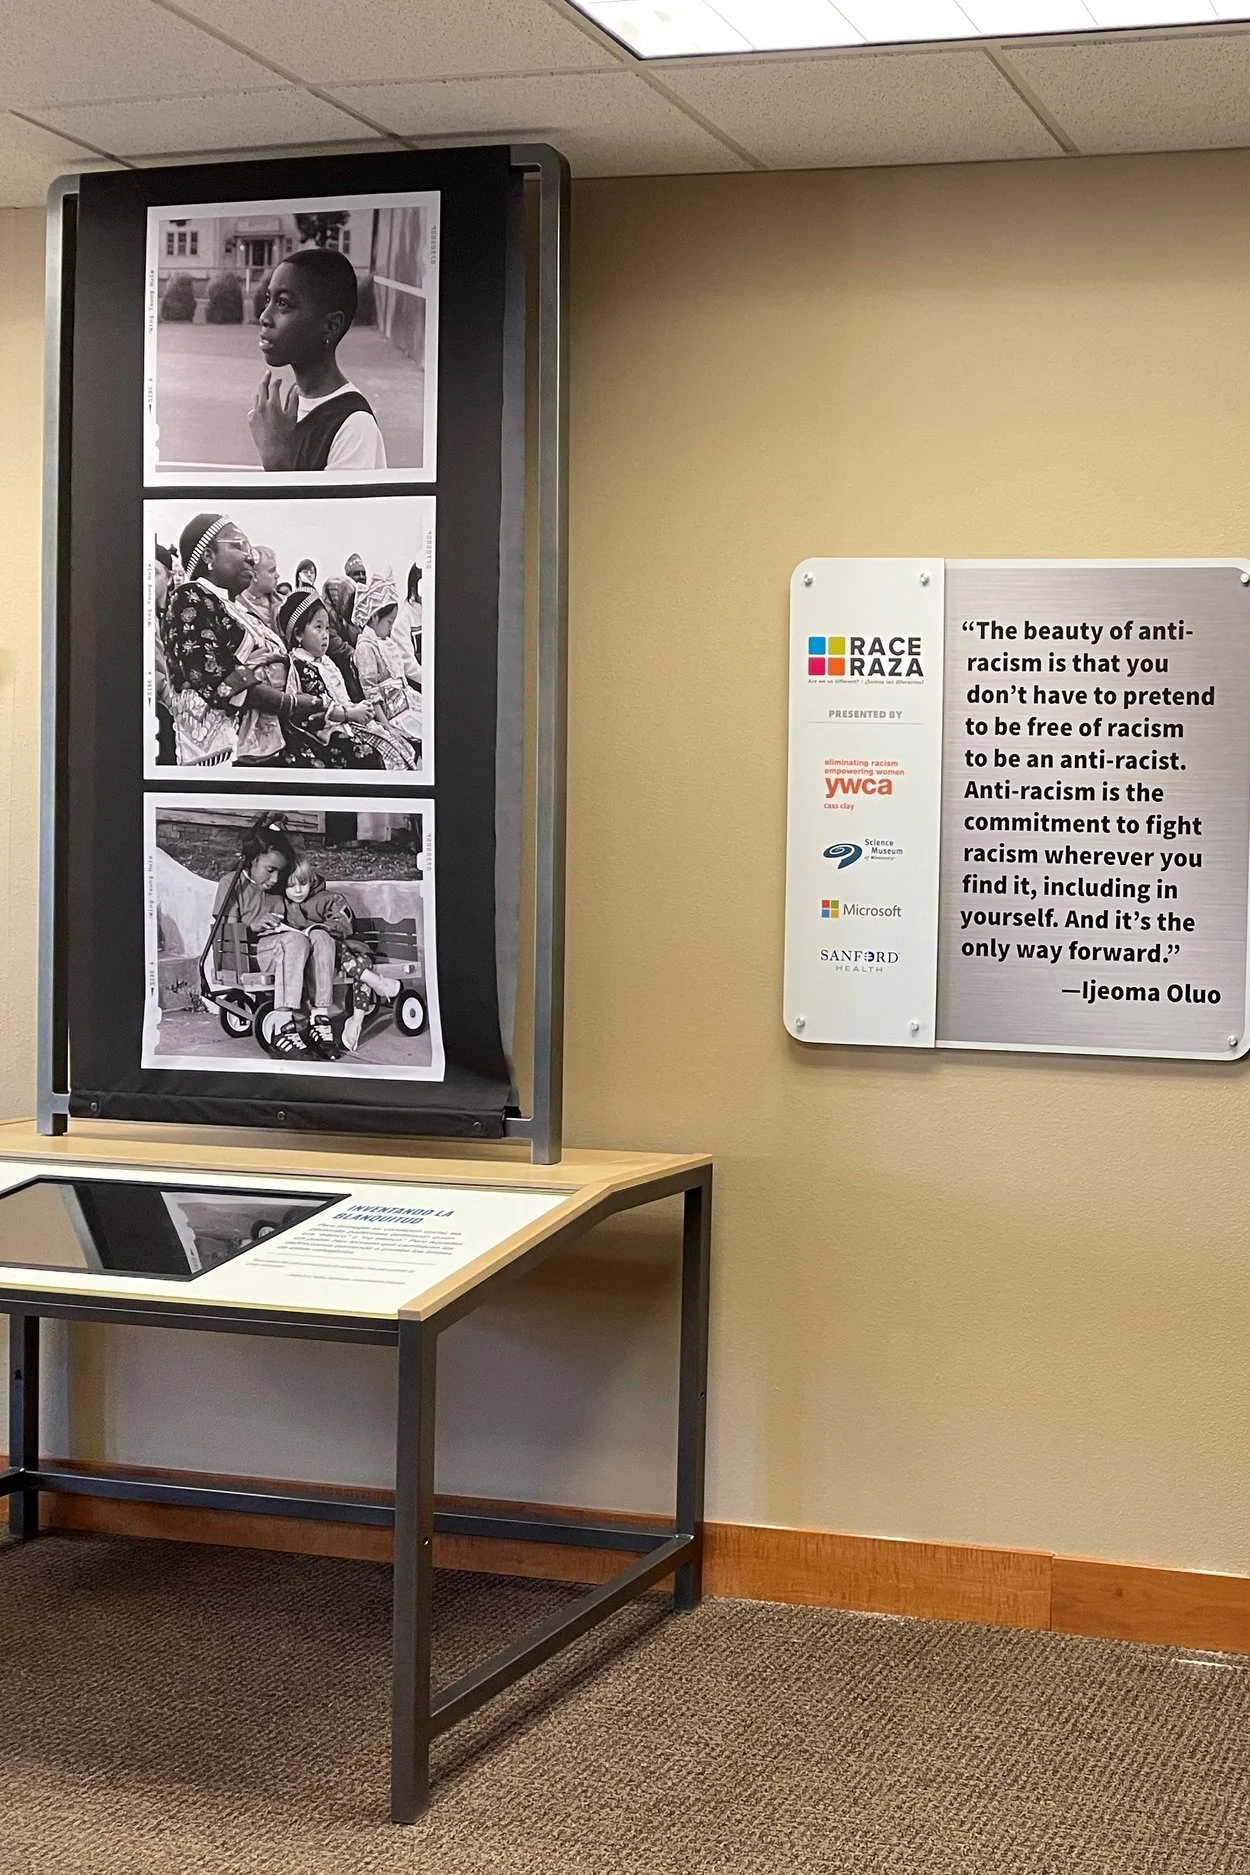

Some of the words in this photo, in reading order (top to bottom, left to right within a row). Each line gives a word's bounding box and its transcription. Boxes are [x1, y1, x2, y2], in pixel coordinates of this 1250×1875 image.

[963, 621, 1017, 639] “The
[1025, 621, 1103, 644] beauty
[1110, 621, 1133, 639] of
[1139, 620, 1193, 640] anti-
[850, 637, 921, 656] RACE
[850, 657, 924, 677] RAZA
[968, 652, 1041, 671] racism
[1049, 652, 1066, 672] is
[1072, 653, 1120, 672] that
[1127, 659, 1168, 677] you
[967, 685, 1026, 703] don’t
[1034, 685, 1087, 704] have
[1094, 687, 1116, 704] to
[1124, 686, 1214, 709] pretend
[829, 710, 886, 718] PRESENTED
[889, 710, 903, 718] BY
[966, 718, 987, 735] to
[995, 717, 1020, 735] be
[1028, 717, 1072, 736] free
[1079, 718, 1102, 736] of
[1108, 717, 1183, 737] racism
[824, 759, 869, 767] eliminating
[965, 750, 987, 767] to
[995, 749, 1020, 767] be
[1027, 754, 1053, 768] an
[1061, 749, 1186, 770] anti-racist.
[824, 768, 874, 776] empowering
[825, 777, 893, 799] ywca
[964, 780, 1094, 800] Anti-racism
[1103, 781, 1119, 801] is
[1126, 783, 1163, 802] the
[840, 803, 855, 811] clay
[965, 812, 1110, 833] commitment
[1117, 817, 1139, 833] to
[1146, 815, 1201, 839] fight
[864, 838, 894, 846] Science
[871, 847, 903, 855] Museum
[965, 843, 1037, 863] racism
[1045, 846, 1154, 866] wherever
[1160, 853, 1201, 871] you
[963, 874, 1006, 894] find
[1014, 875, 1036, 900] it,
[1044, 876, 1150, 903] including
[1157, 879, 1177, 898] in
[843, 904, 902, 918] Microsoft
[961, 908, 1058, 929] yourself.
[1065, 910, 1108, 928] And
[1116, 910, 1150, 930] it’s
[1157, 912, 1195, 931] the
[821, 950, 899, 963] SANFORD
[962, 938, 1010, 962] only
[1017, 944, 1062, 963] way
[1069, 941, 1179, 963] forward.”
[1062, 980, 1159, 1003] —Ijeoma
[1168, 984, 1220, 1004] Oluo
[333, 1213, 424, 1224] BLANQUITUD
[347, 1205, 434, 1216] INVENTANDO
